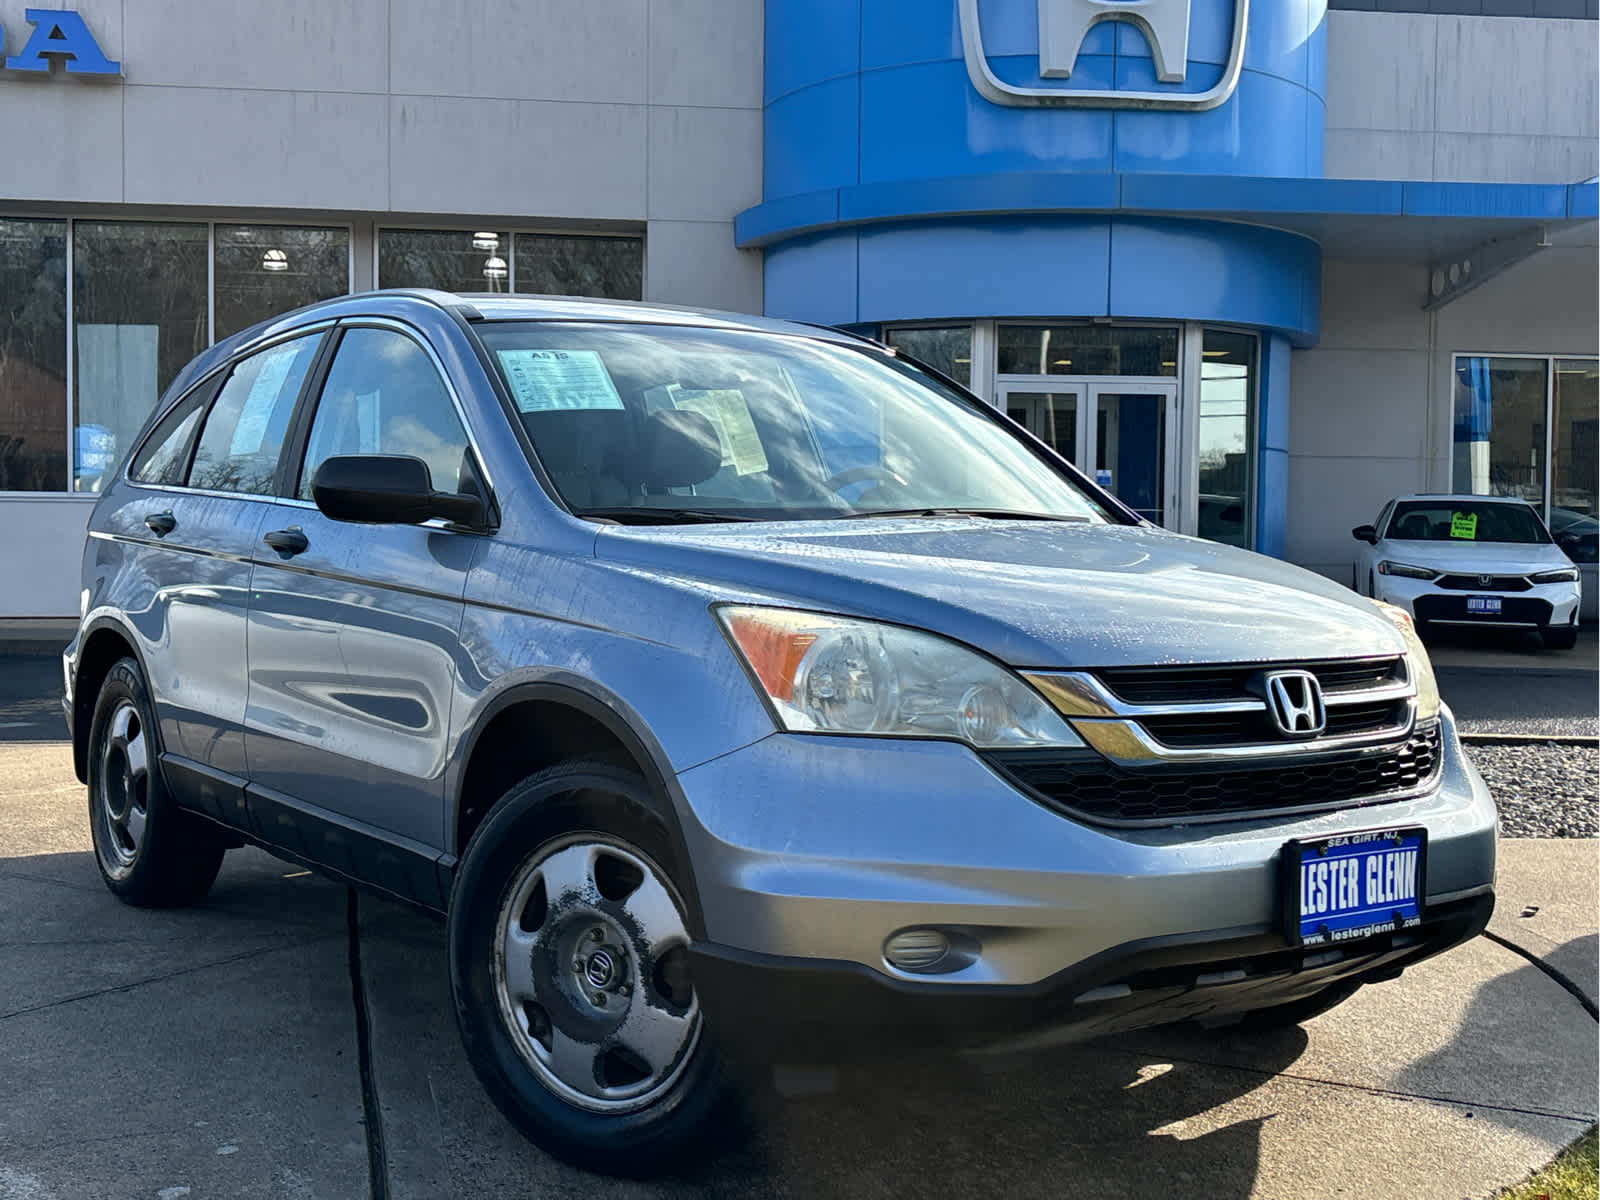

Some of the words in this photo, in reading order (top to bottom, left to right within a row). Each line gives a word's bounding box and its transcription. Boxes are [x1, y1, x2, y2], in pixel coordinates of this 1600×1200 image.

[0, 8, 121, 75] A
[1327, 838, 1350, 848] SEA
[1352, 834, 1381, 845] GIRT,
[1383, 831, 1398, 840] NJ
[1300, 858, 1359, 916] LESTER
[1366, 851, 1417, 905] GLENN
[1331, 923, 1396, 940] lesterglenn
